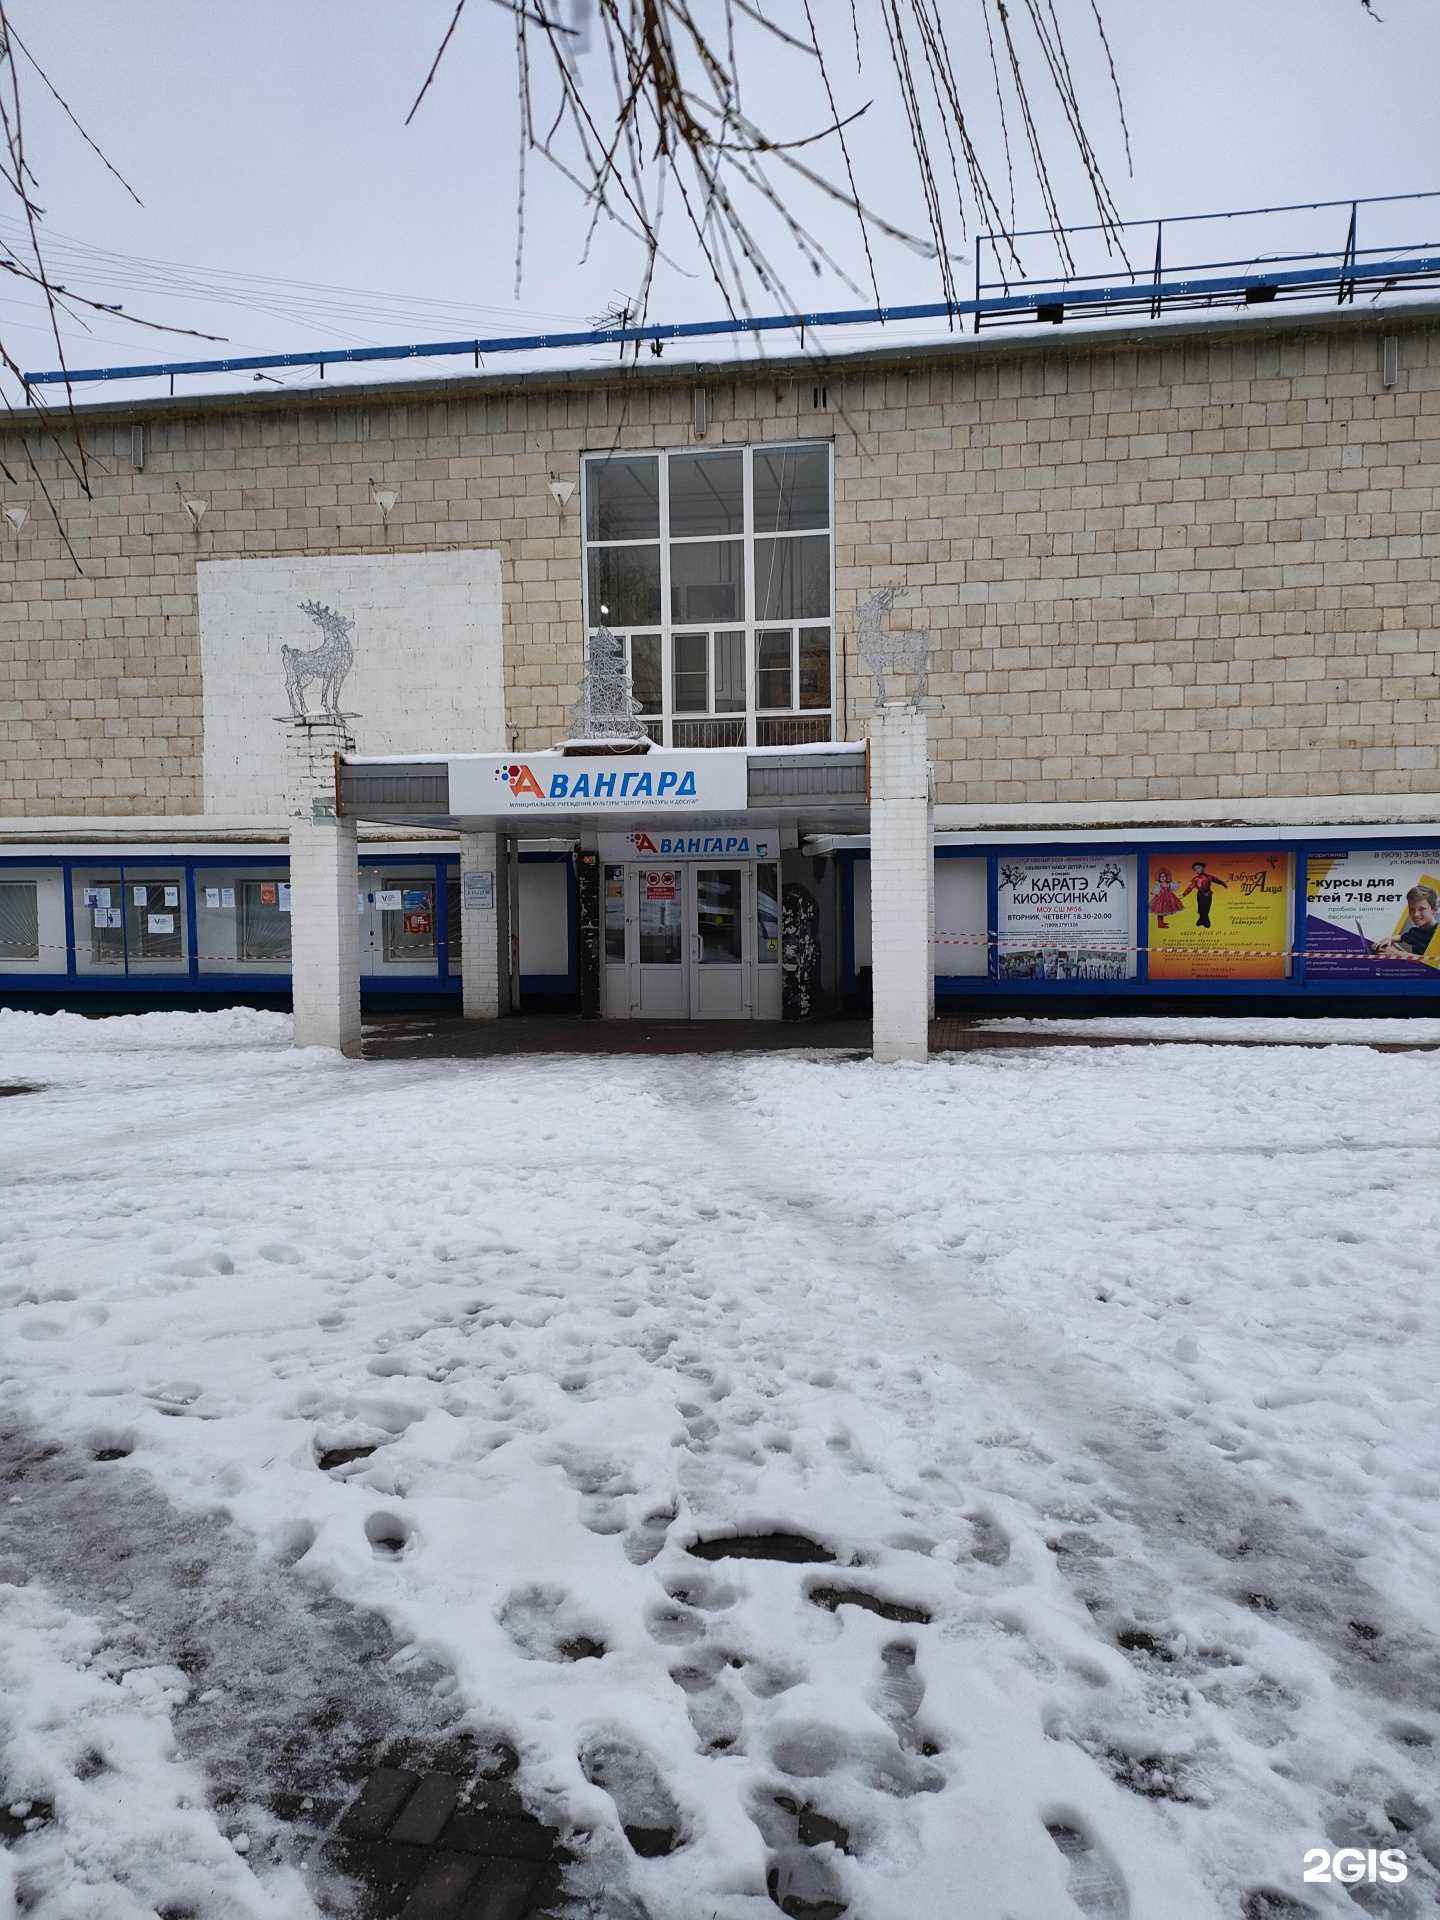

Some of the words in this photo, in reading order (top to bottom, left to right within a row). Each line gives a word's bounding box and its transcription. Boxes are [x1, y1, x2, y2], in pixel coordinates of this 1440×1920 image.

[510, 765, 697, 798] АВАНГАРД
[635, 833, 750, 853] АВАНГАРД
[1031, 877, 1088, 891] КАРАТЭ
[1367, 878, 1394, 888] для
[1013, 890, 1108, 905] КИОКУСИНКАЙ
[1345, 893, 1372, 902] 7-18
[1377, 893, 1402, 903] лет
